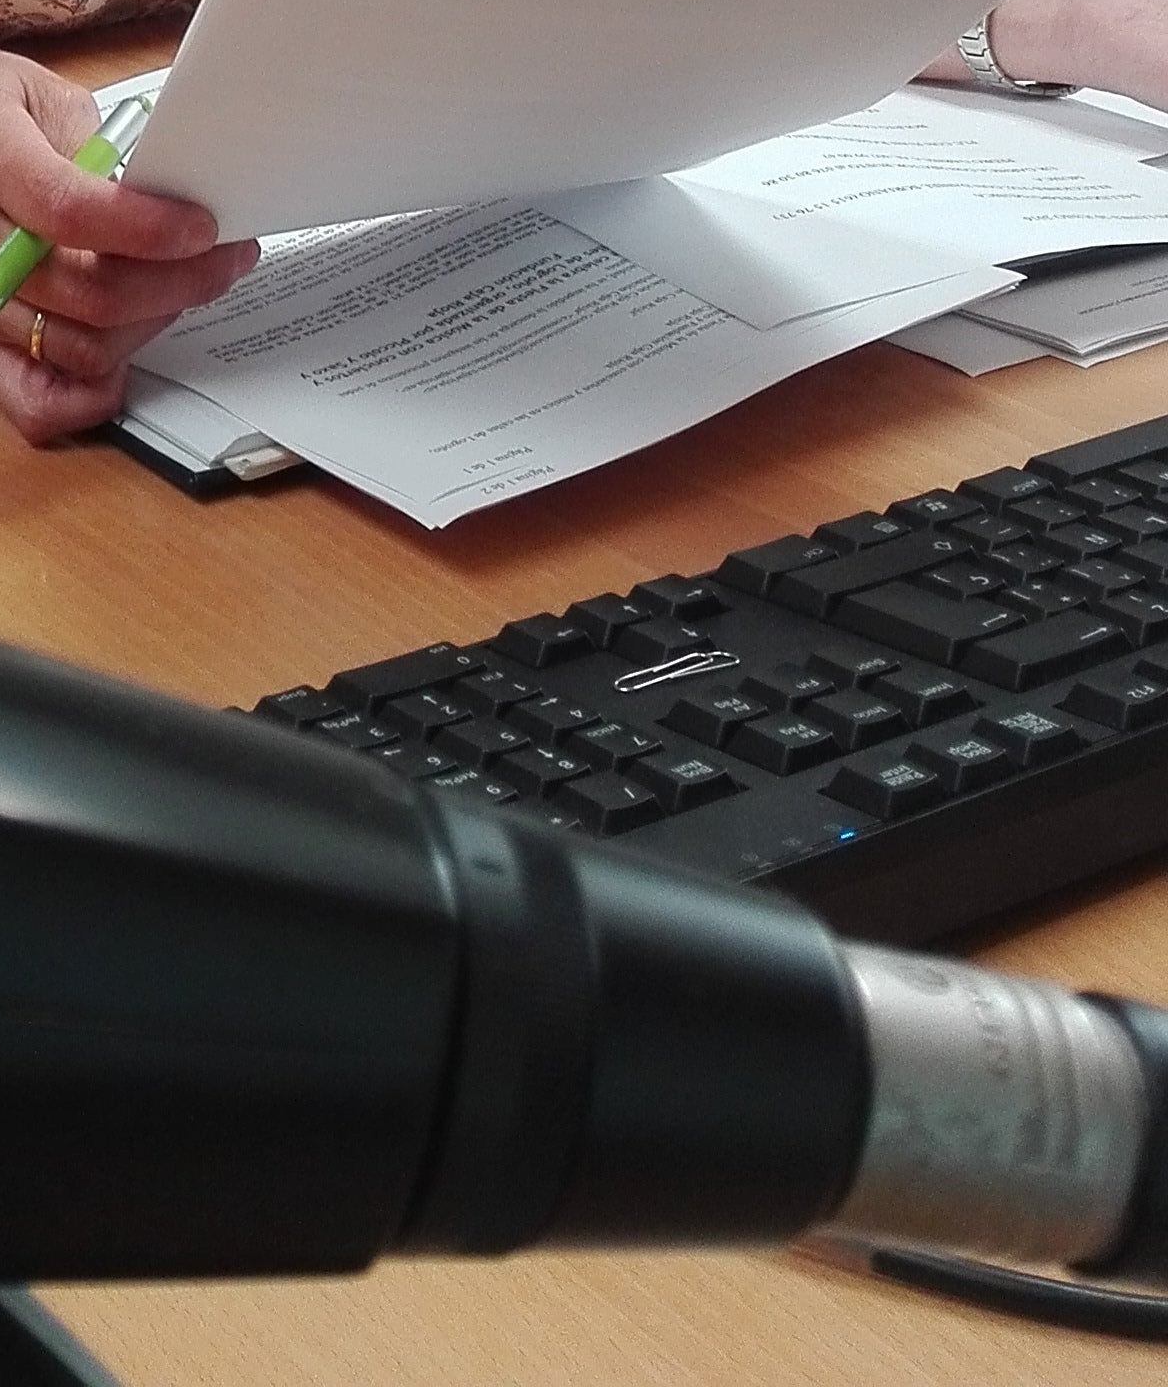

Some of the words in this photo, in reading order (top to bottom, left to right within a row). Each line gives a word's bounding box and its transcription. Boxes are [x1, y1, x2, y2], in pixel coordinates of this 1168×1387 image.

[564, 255, 582, 263] de
[494, 253, 561, 284] Fundación
[561, 256, 609, 277] celebra
[506, 263, 566, 289] Logroño,
[463, 285, 494, 300] Caja
[505, 284, 548, 304] Fiesta
[427, 300, 464, 317] Rioja
[436, 291, 505, 326] organizada
[487, 305, 505, 314] de
[412, 325, 434, 338] por
[425, 322, 471, 343] Música
[359, 337, 410, 358] Piccolo
[397, 343, 423, 355] con
[312, 361, 347, 374] Saxo
[325, 354, 396, 381] conciertos
[494, 446, 532, 461] Página
[515, 465, 554, 480] Página
[457, 656, 470, 664] 0
[1128, 685, 1155, 698] F12
[569, 709, 583, 718] 4
[500, 732, 516, 741] 5
[633, 736, 648, 746] 7
[427, 756, 441, 766] 6
[558, 760, 574, 769] 8
[486, 785, 501, 795] 9
